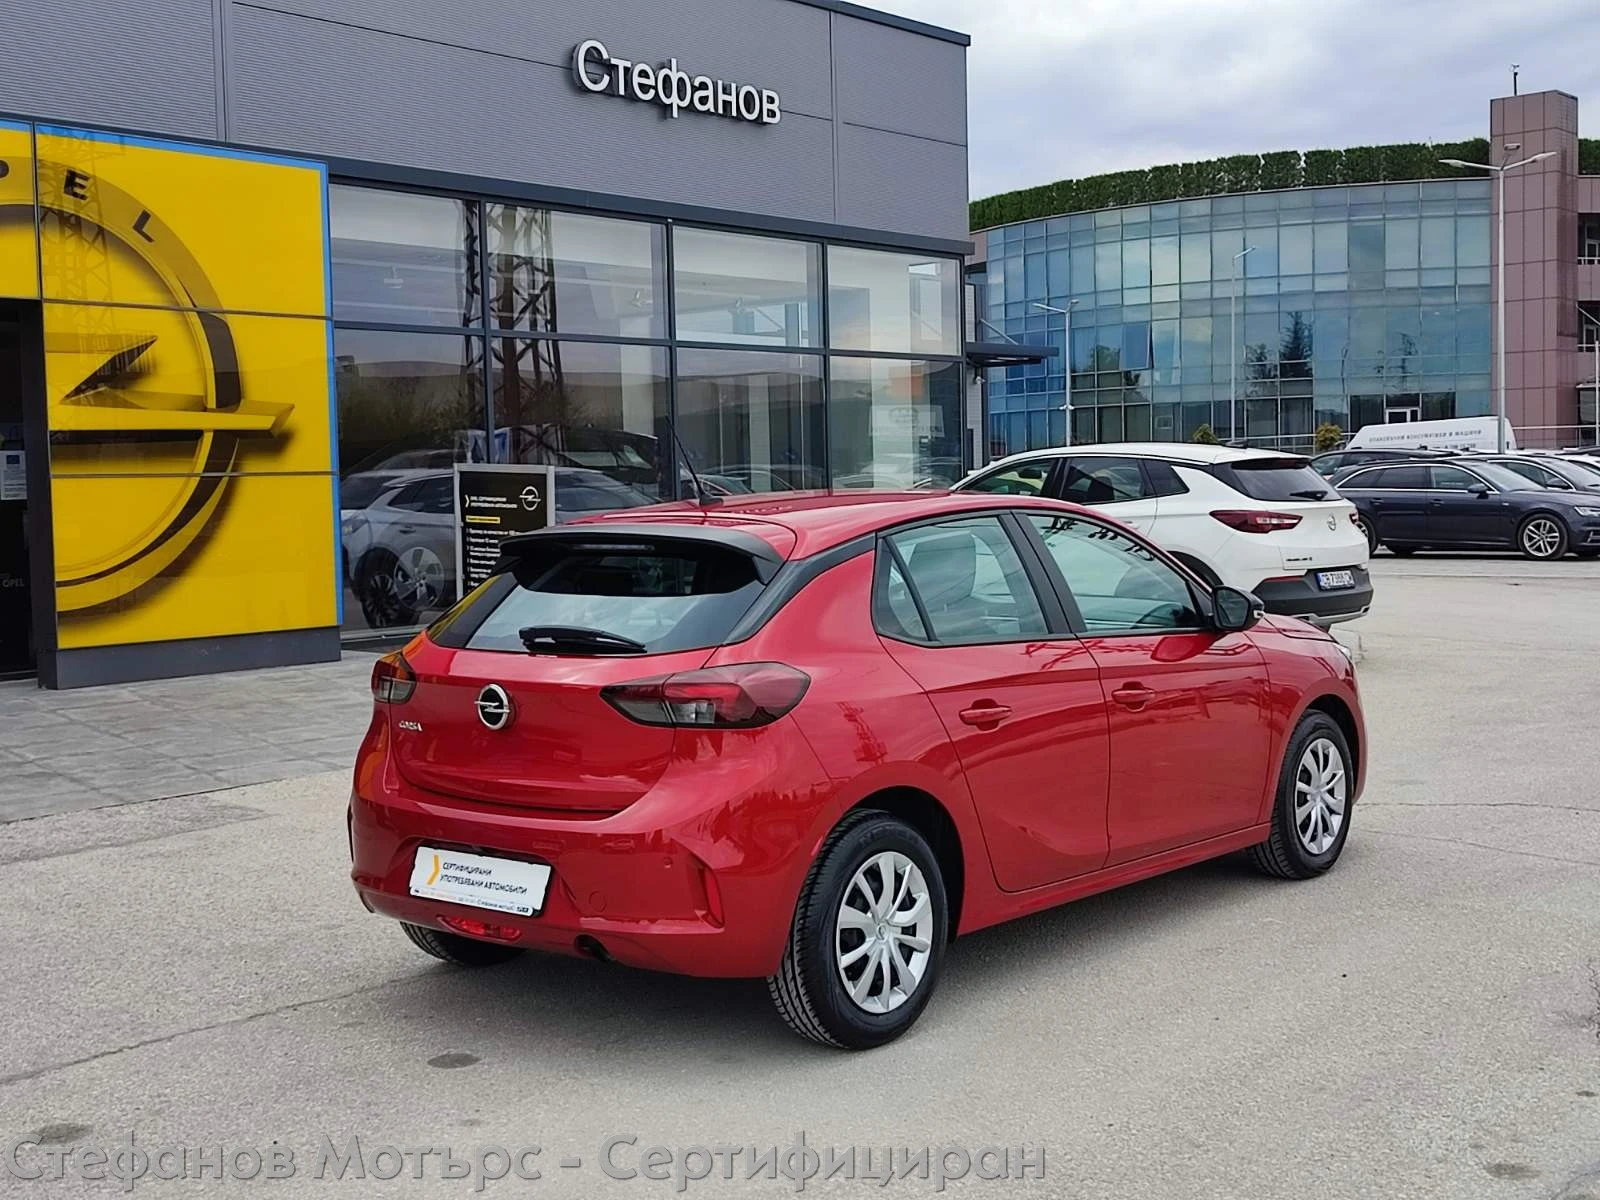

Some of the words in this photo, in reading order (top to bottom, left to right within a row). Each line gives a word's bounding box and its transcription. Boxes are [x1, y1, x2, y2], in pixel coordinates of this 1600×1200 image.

[573, 39, 781, 124] Стефанов
[442, 861, 492, 876] СЕРТИФИЦИРАНИ
[484, 881, 528, 896] АВТОМОБИЛИ
